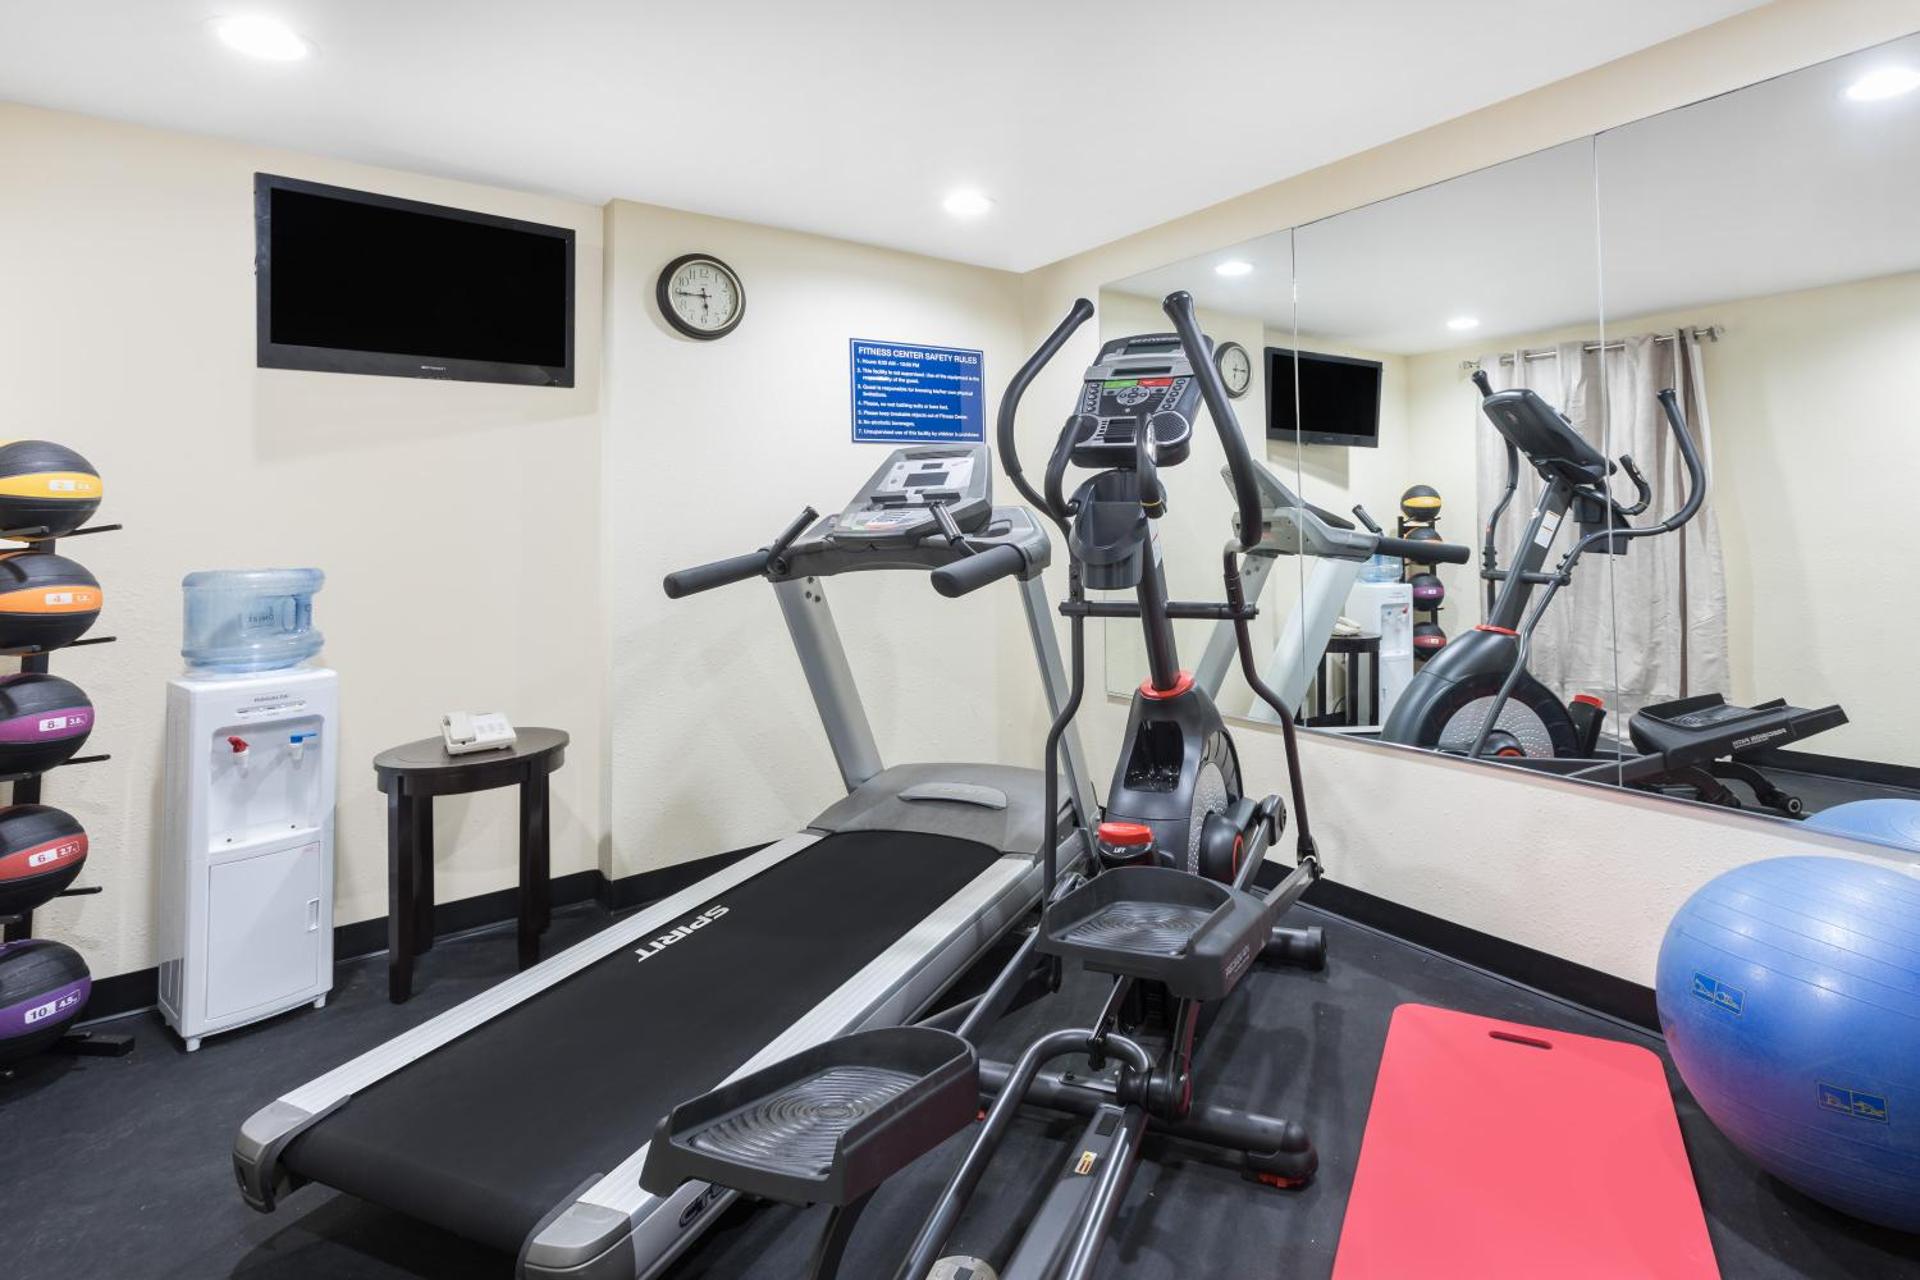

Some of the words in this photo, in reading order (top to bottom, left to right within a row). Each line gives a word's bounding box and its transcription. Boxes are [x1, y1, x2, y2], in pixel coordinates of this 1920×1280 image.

[858, 346, 891, 357] FITNESS
[893, 349, 923, 359] CENTER
[924, 352, 952, 362] SAFETY
[954, 355, 978, 365] RULES
[38, 854, 46, 863] 6
[634, 904, 730, 963] SPIRIT
[30, 1007, 47, 1020] 10
